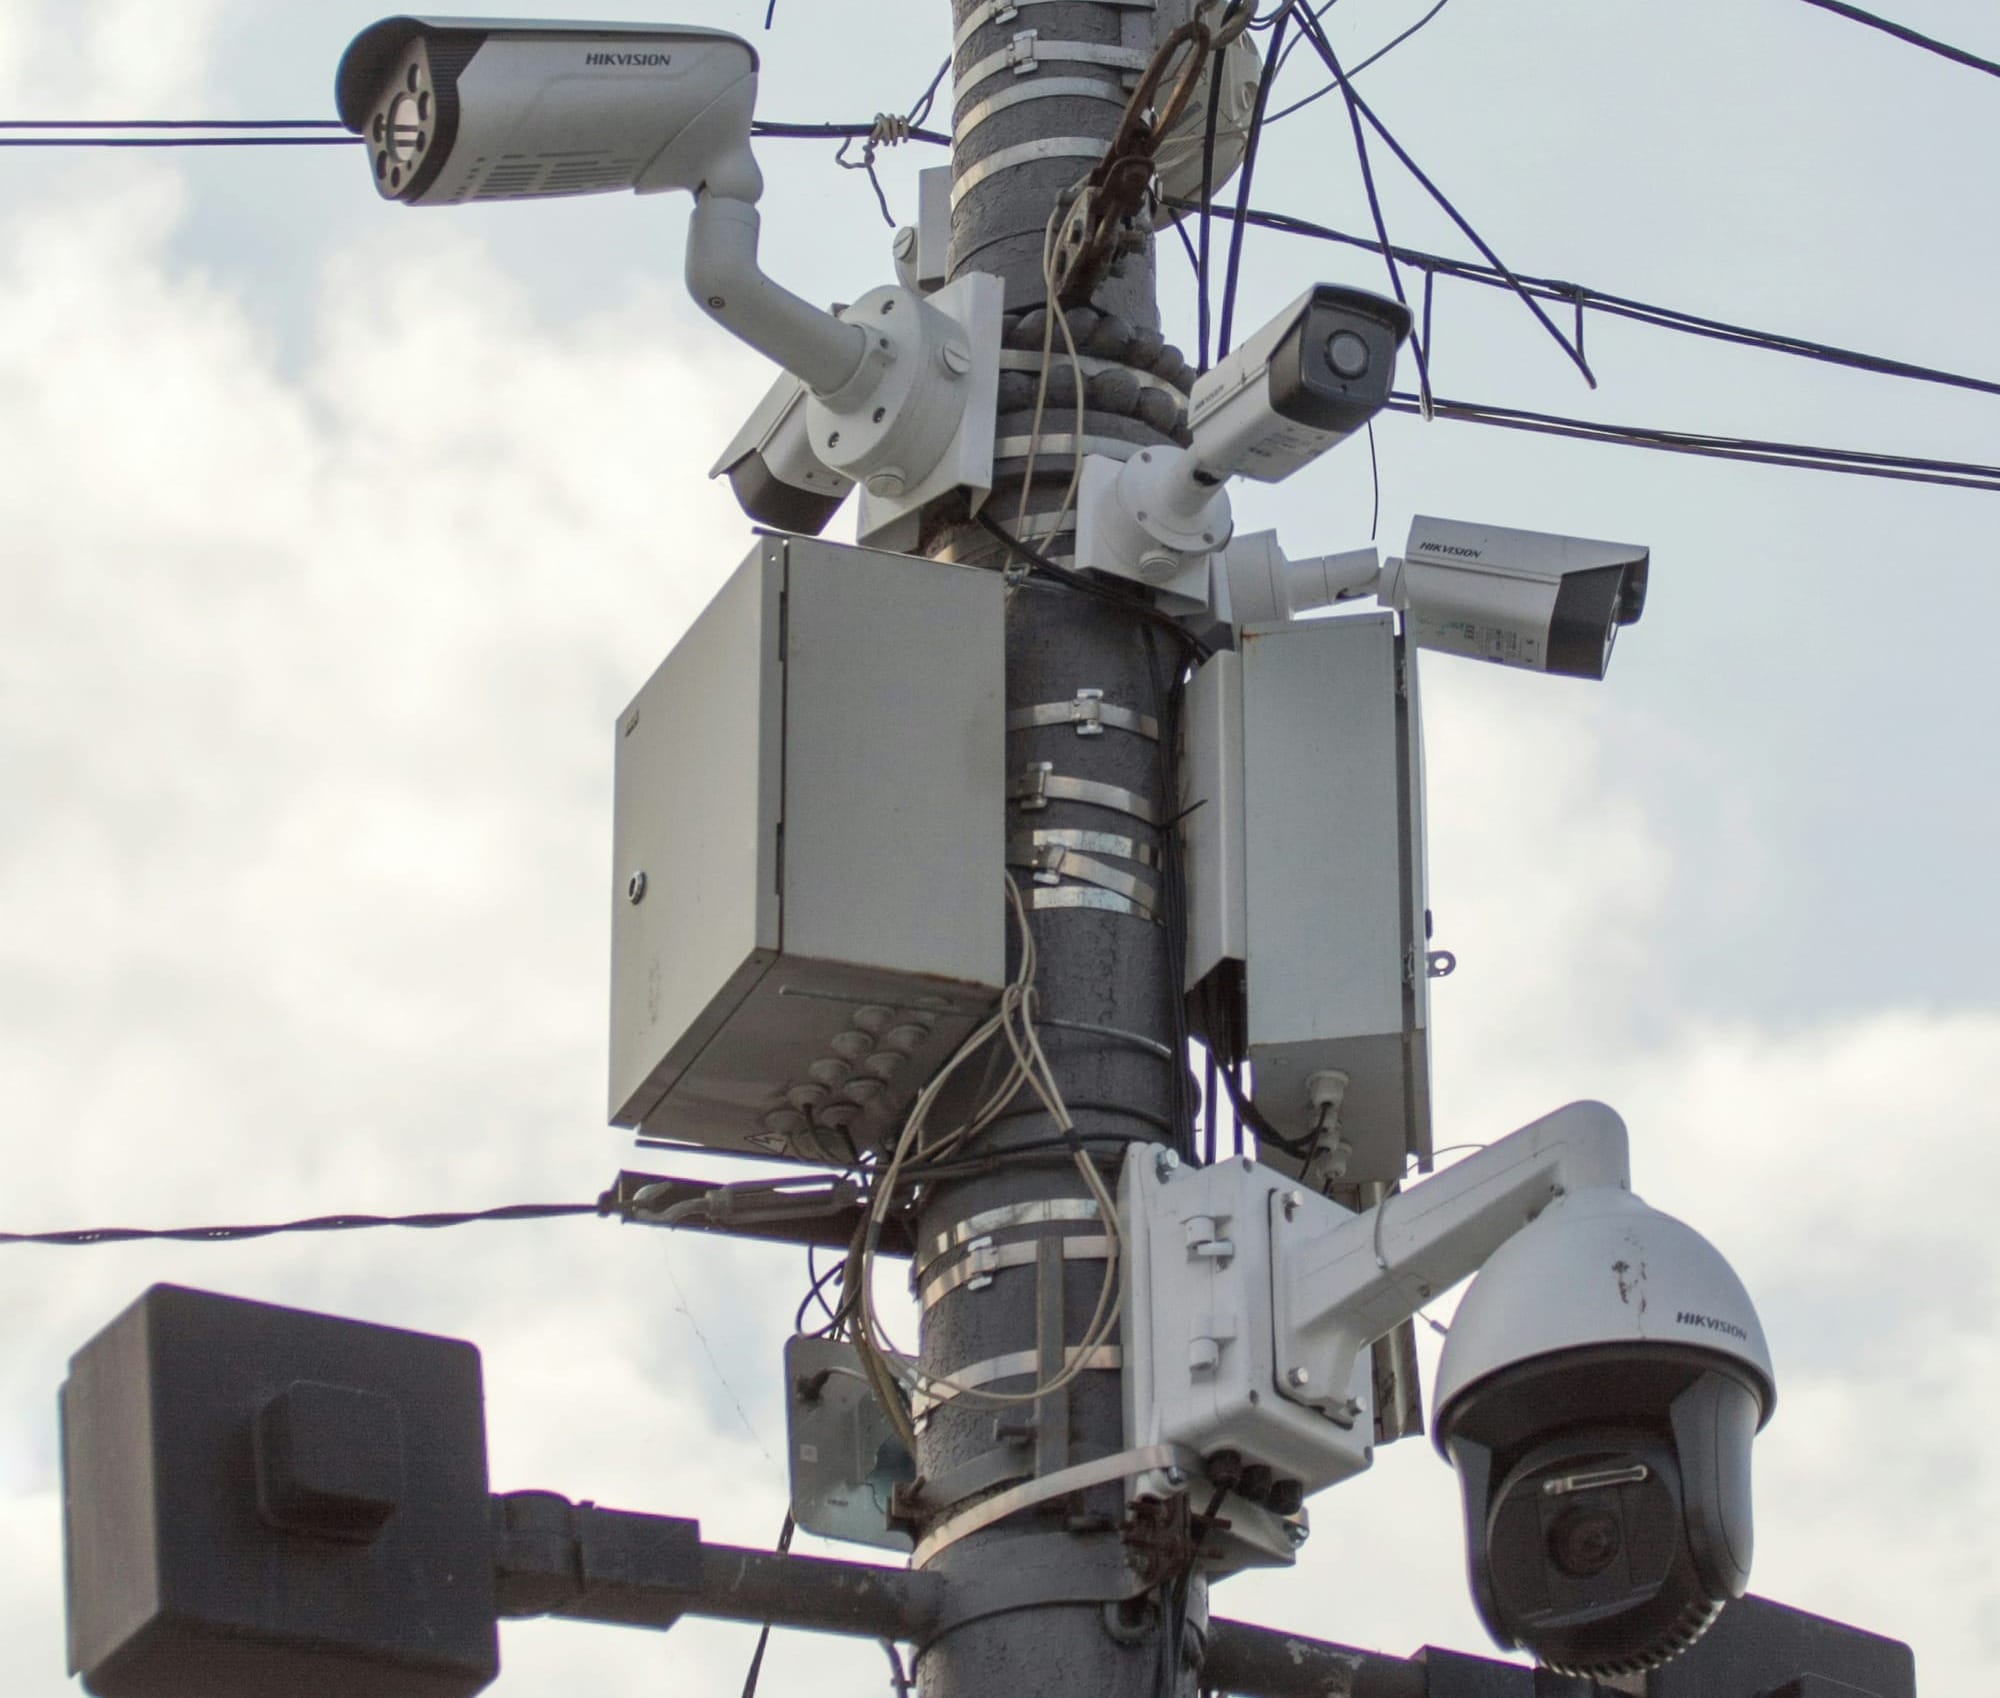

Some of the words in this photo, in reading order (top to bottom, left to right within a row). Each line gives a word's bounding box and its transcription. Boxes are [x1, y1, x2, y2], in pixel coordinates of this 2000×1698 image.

[585, 53, 671, 66] HIKVISION
[1419, 541, 1482, 559] HIKVISION
[1676, 1311, 1747, 1341] HIKVISION
